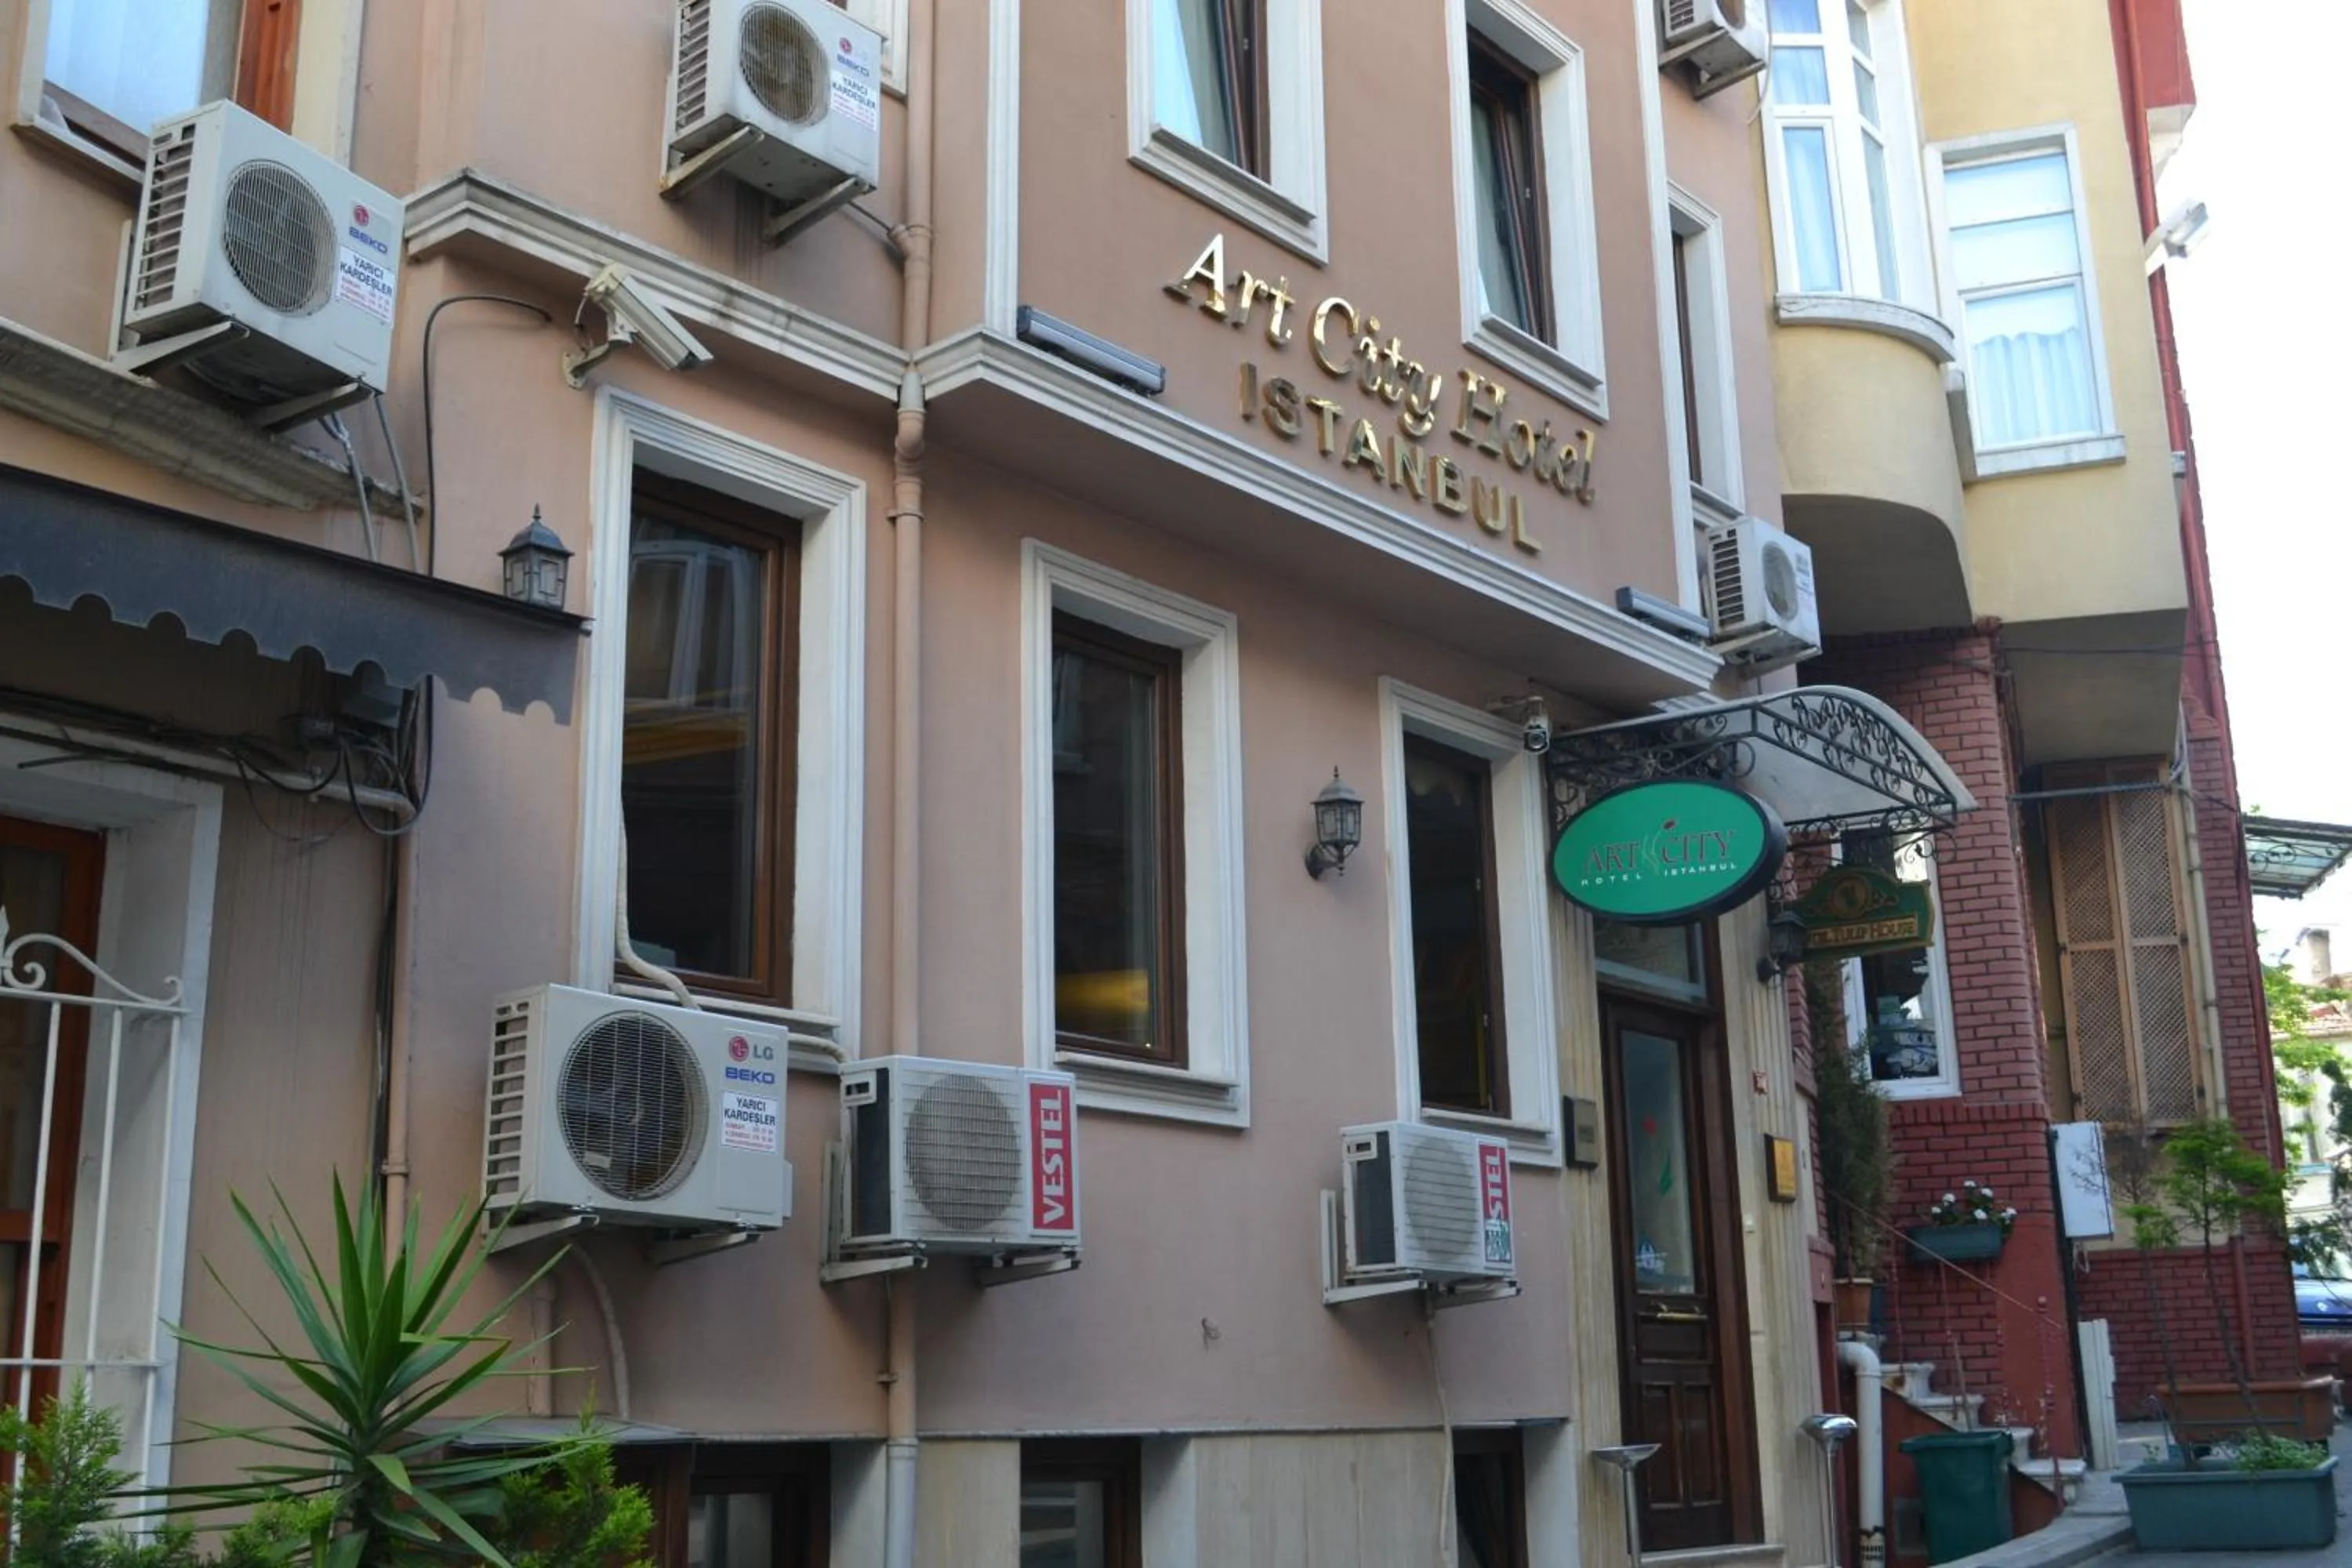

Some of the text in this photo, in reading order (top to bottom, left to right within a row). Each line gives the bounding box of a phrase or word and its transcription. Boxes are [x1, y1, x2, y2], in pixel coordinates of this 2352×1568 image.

[349, 226, 387, 254] BEKO
[1162, 234, 1595, 506] Art City Hotel
[1239, 362, 1542, 554] ISTANBUL
[1583, 829, 1733, 874] ART CITY
[1581, 873, 1642, 887] HOTEL
[725, 1065, 775, 1084] BEKO
[753, 1044, 774, 1061] LG
[1040, 1088, 1065, 1225] VESTEL
[1486, 1147, 1504, 1221] STEL
